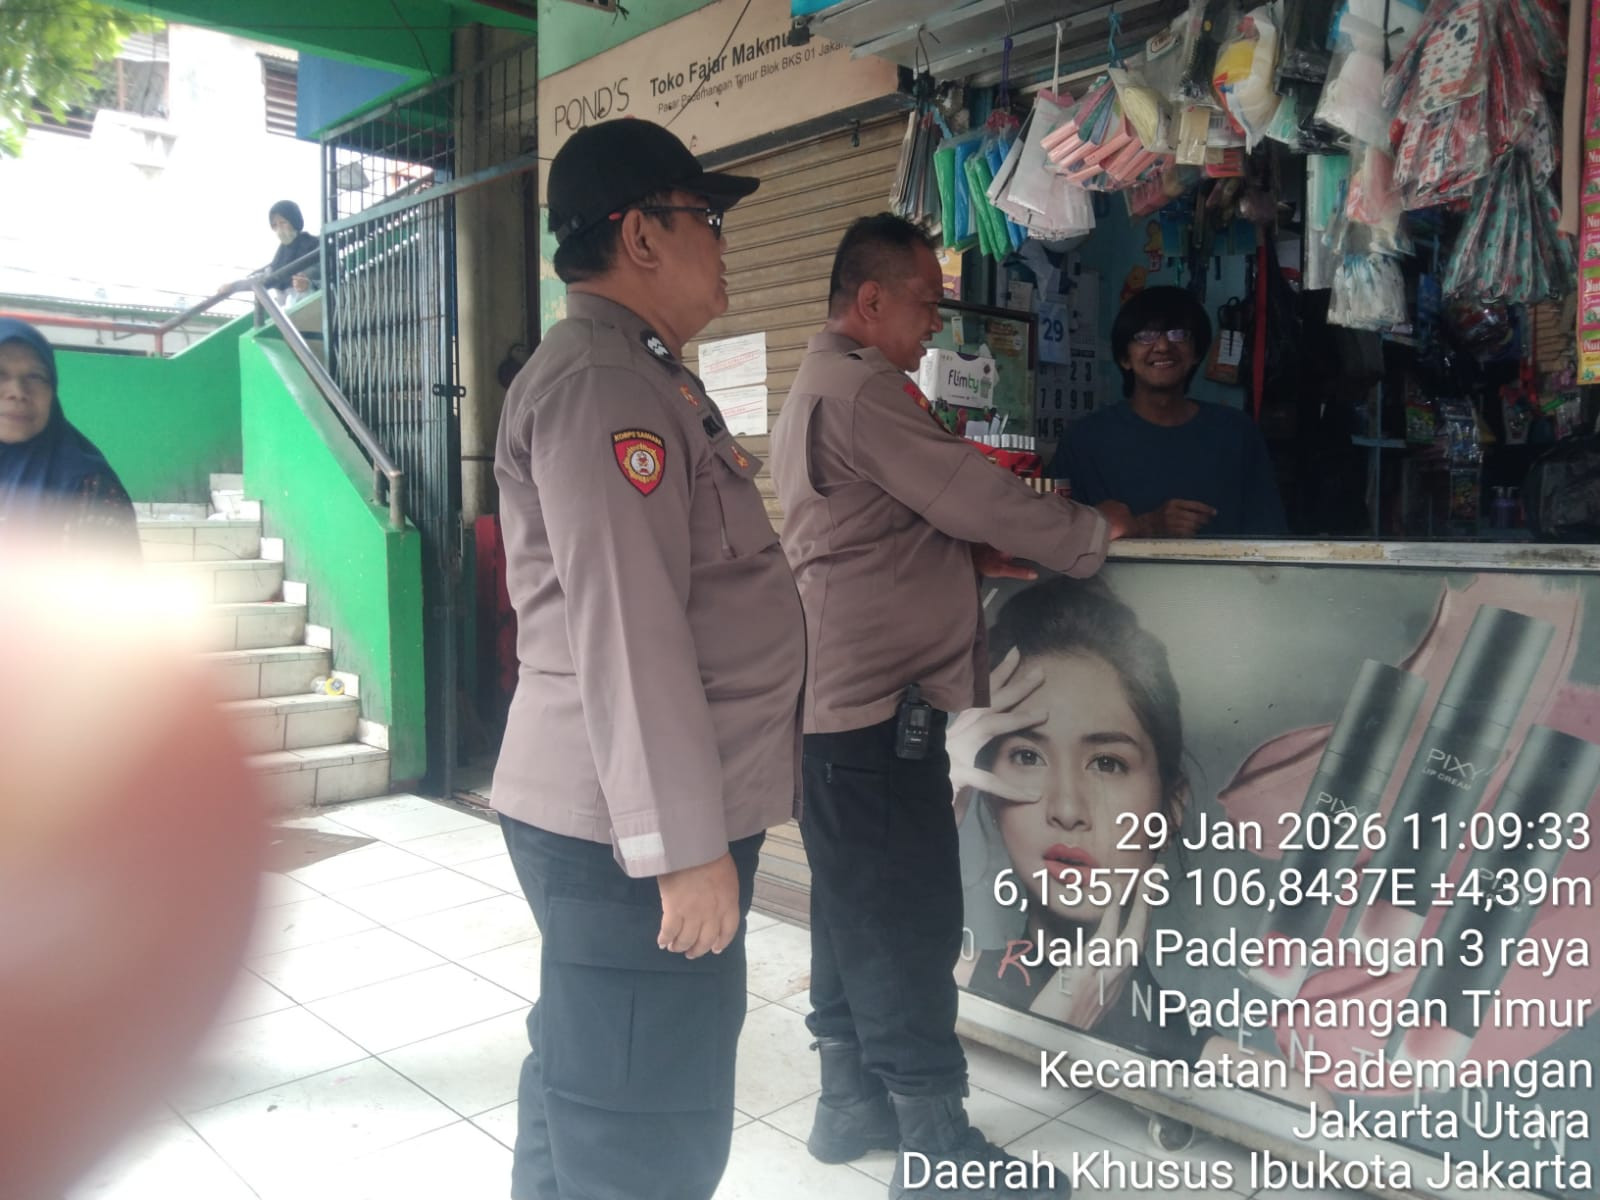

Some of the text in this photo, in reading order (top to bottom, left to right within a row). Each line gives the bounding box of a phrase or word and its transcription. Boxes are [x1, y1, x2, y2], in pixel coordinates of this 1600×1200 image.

[649, 71, 685, 97] Toko
[689, 54, 728, 83] Fajar
[760, 61, 780, 78] Blok
[804, 47, 816, 62] 01
[554, 76, 630, 137] POND'S
[1041, 316, 1065, 343] 29
[1040, 387, 1048, 409] 7
[1069, 388, 1078, 410] 9
[1426, 748, 1487, 781] PIXY
[1437, 773, 1473, 792] CREAM
